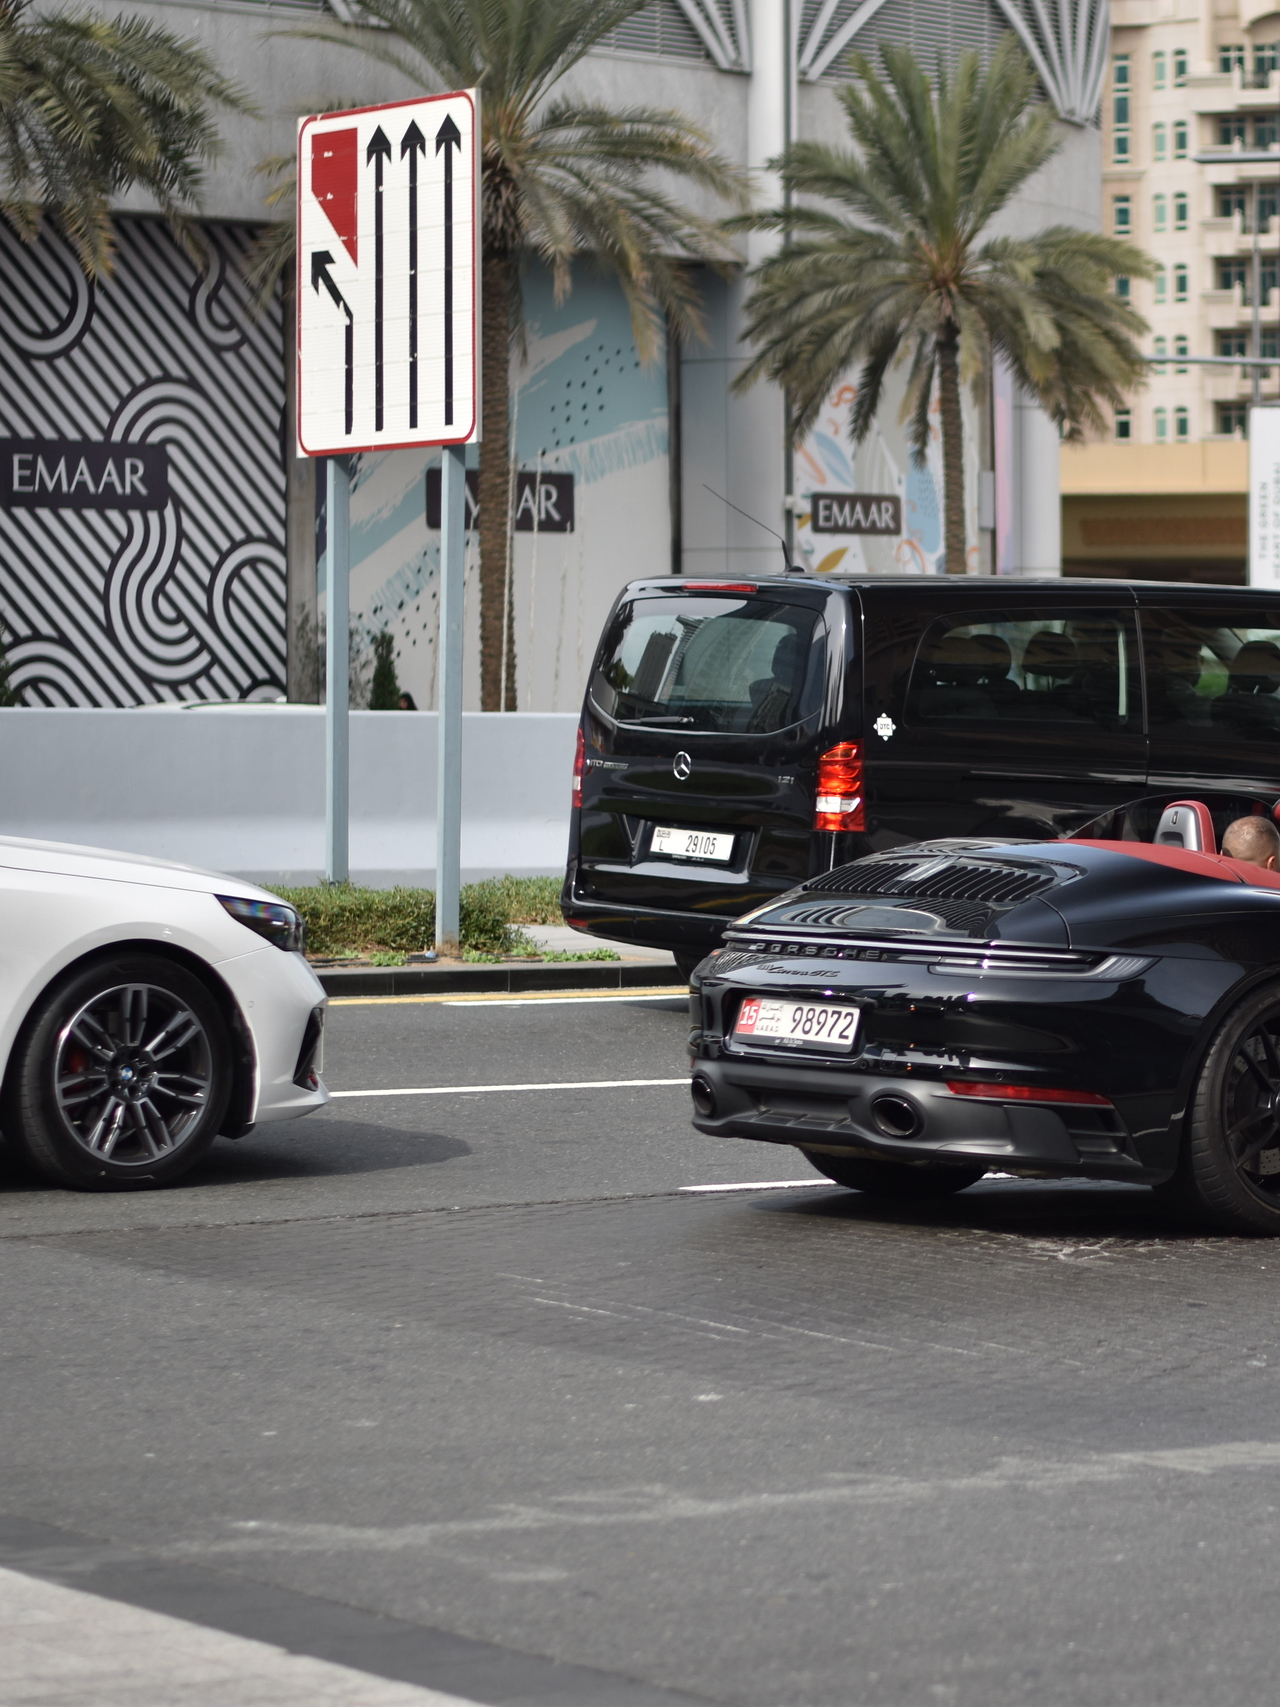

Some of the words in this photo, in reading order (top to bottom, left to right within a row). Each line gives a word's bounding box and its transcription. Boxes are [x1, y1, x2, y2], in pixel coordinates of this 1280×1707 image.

[12, 453, 149, 497] EMAAR
[818, 499, 896, 530] EMAAR
[1258, 481, 1268, 528] GREEN
[659, 840, 664, 851] L
[685, 834, 717, 855] 29105
[754, 942, 880, 960] PORSCHE
[739, 1005, 758, 1025] 15
[790, 1006, 855, 1040] 98972
